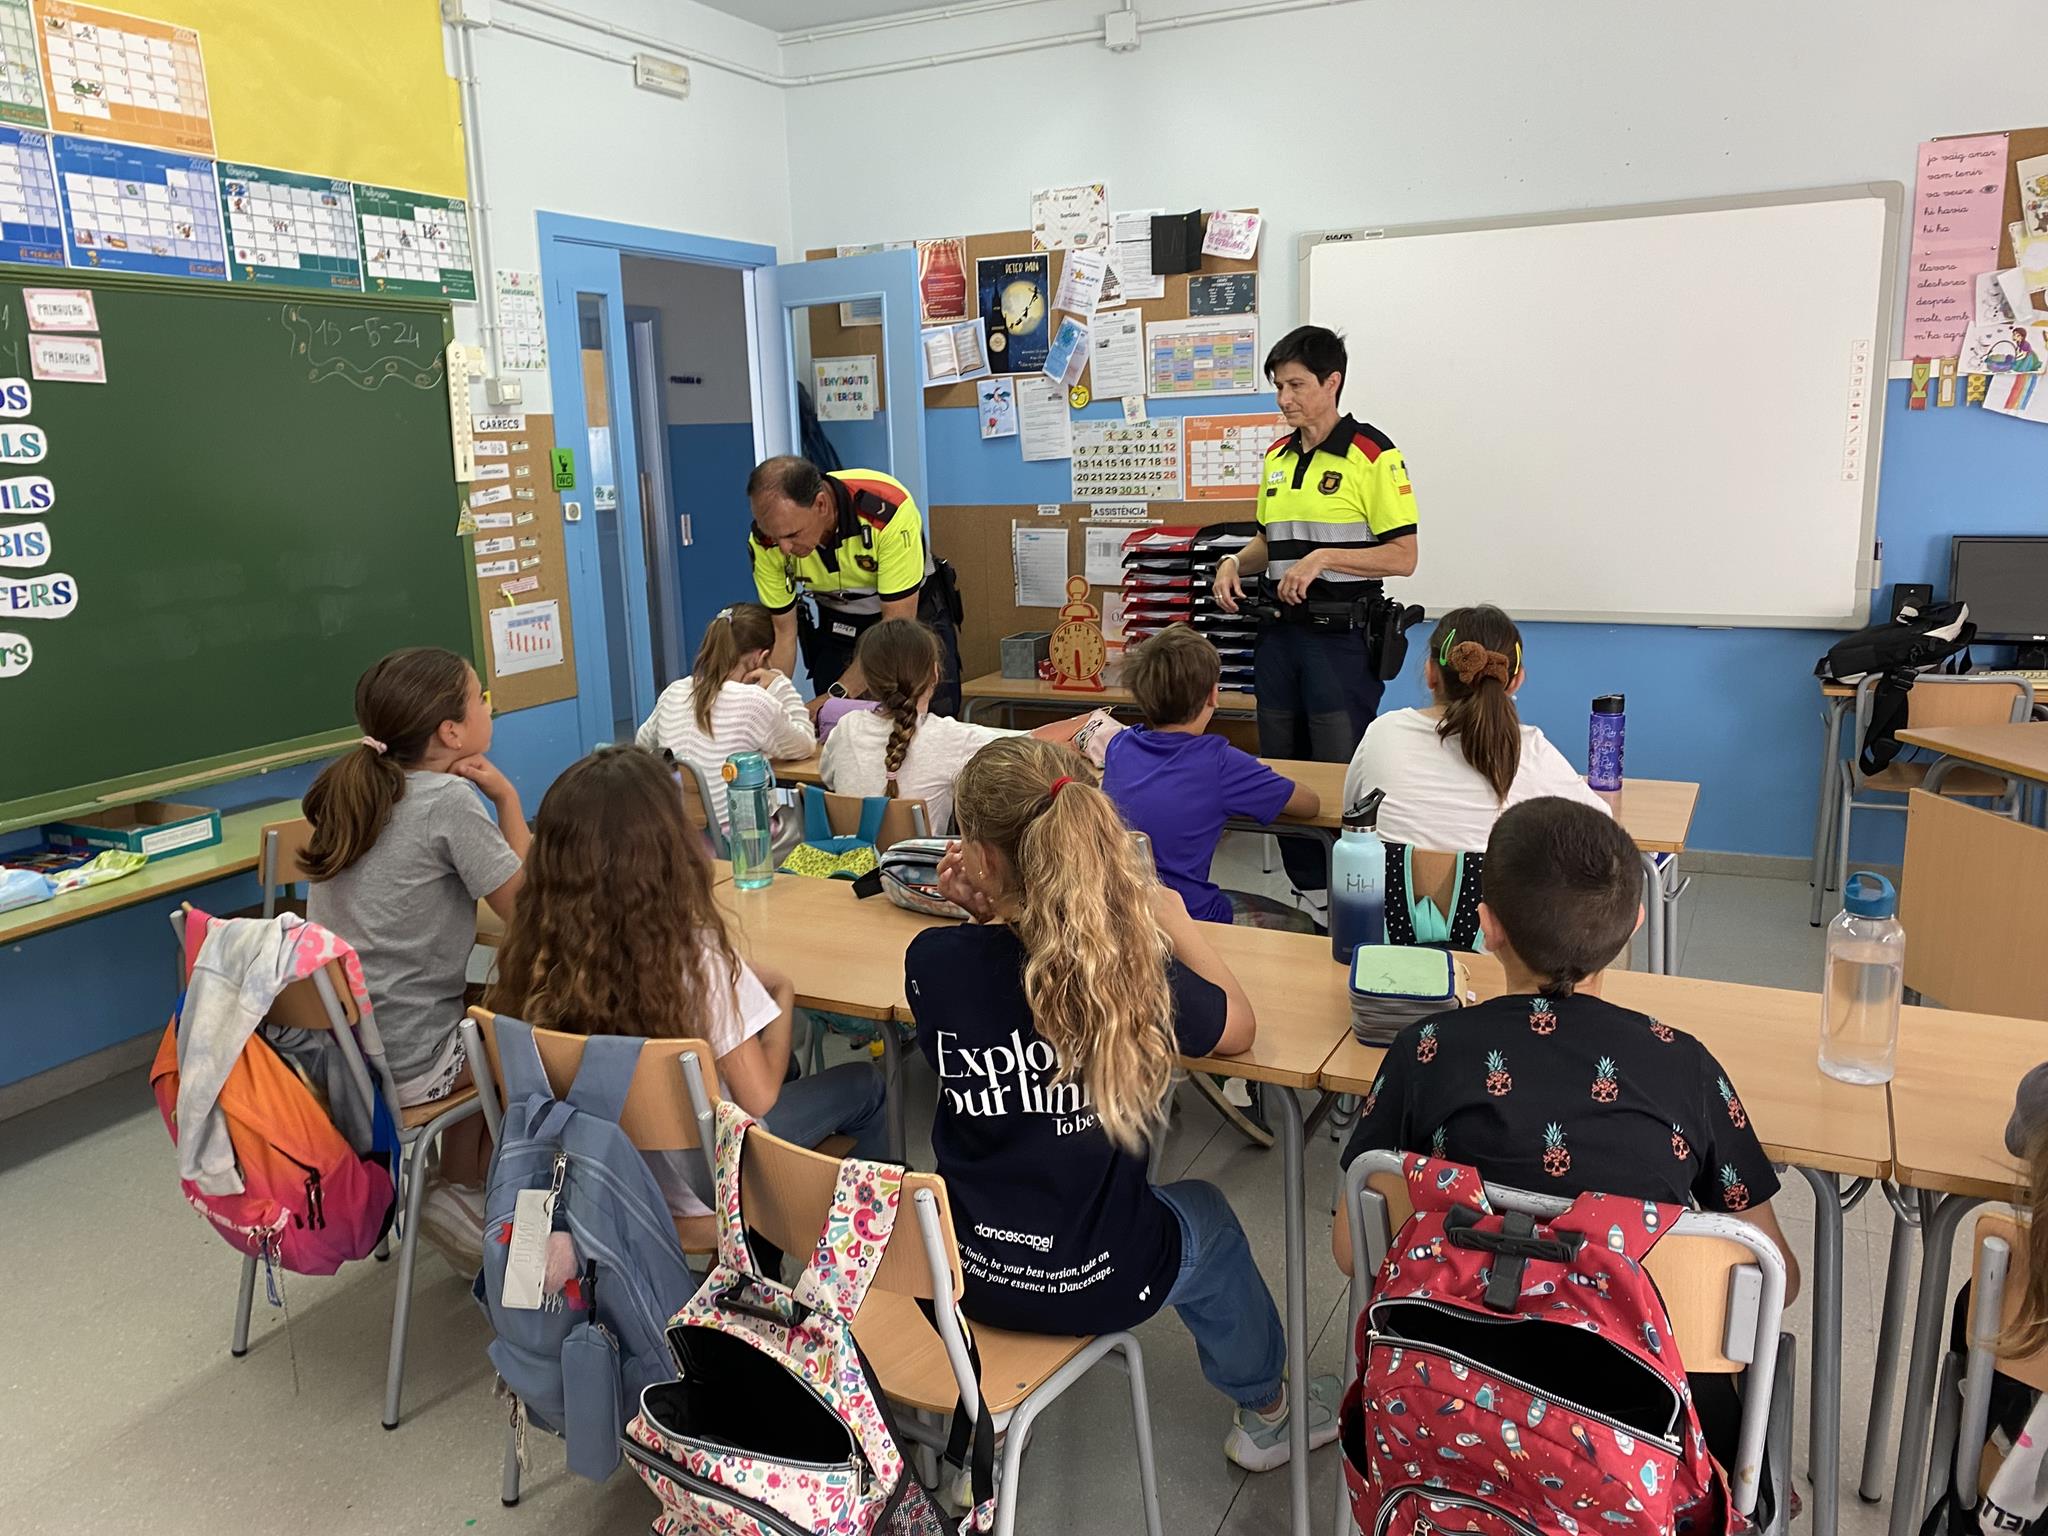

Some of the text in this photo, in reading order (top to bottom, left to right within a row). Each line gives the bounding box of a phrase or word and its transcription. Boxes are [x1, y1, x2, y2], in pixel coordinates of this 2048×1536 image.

[1136, 430, 1143, 439] 3
[1151, 429, 1158, 438] 4
[1167, 429, 1174, 437] 5
[1079, 443, 1176, 455] 6 7 8 9 10 11 12
[1077, 457, 1176, 468] 13 14 15 16 17 18 19
[558, 476, 572, 485] WC
[1091, 473, 1102, 481] 21
[1105, 473, 1117, 481] 22
[1120, 472, 1131, 480] 23
[1134, 472, 1146, 480] 24
[1149, 471, 1161, 480] 25
[1163, 471, 1176, 479] 26
[1077, 487, 1089, 495] 27
[1091, 487, 1103, 495] 28
[1120, 486, 1131, 494] 30
[1134, 486, 1146, 494] 31
[1052, 1117, 1073, 1136] To
[1076, 1113, 1095, 1132] be
[990, 1257, 1001, 1270] be
[1002, 1264, 1025, 1275] your
[1026, 1266, 1044, 1279] best
[1045, 1268, 1080, 1281] version,
[1098, 1250, 1110, 1263] on
[967, 1261, 987, 1279] find
[987, 1273, 1009, 1285] your
[1010, 1279, 1046, 1293] essence
[1047, 1283, 1057, 1293] in
[1059, 1265, 1115, 1294] Dancescape.
